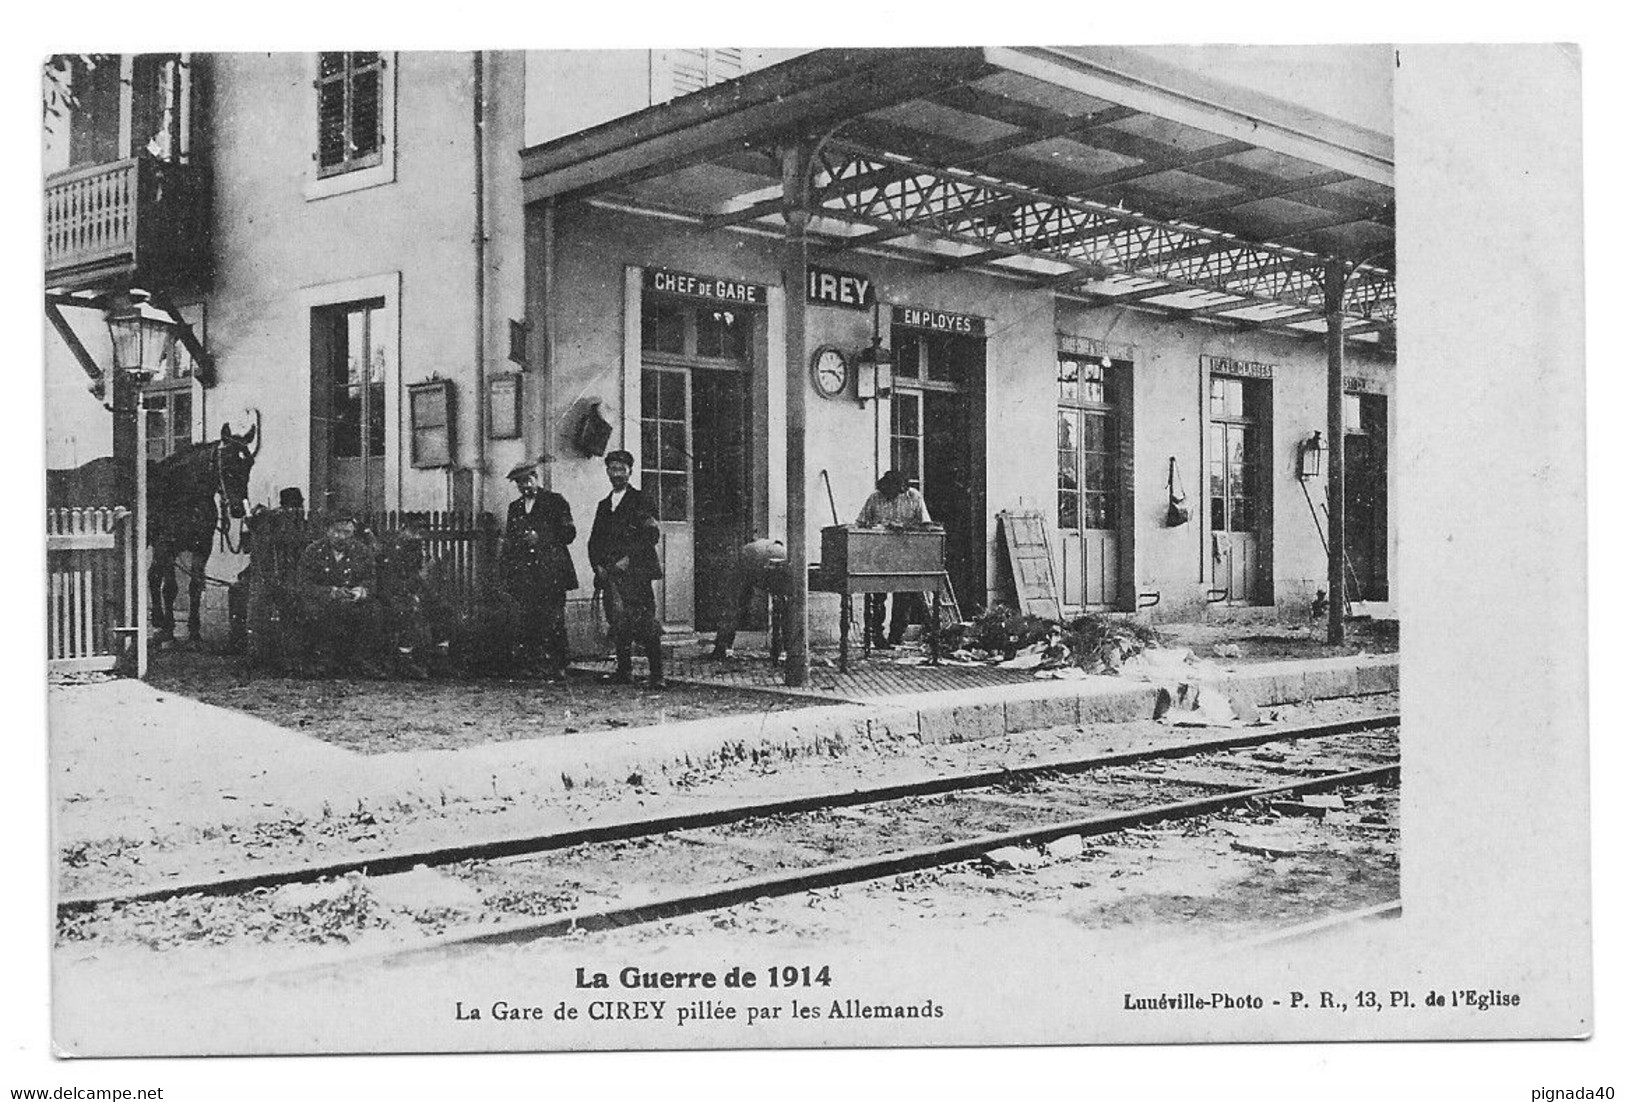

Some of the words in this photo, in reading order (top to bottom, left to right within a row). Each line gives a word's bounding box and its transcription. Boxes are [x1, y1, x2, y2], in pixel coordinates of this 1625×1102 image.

[655, 272, 695, 293] CHEF
[716, 280, 756, 302] GARE
[810, 270, 869, 304] IREY
[904, 308, 972, 332] EMPLOYES
